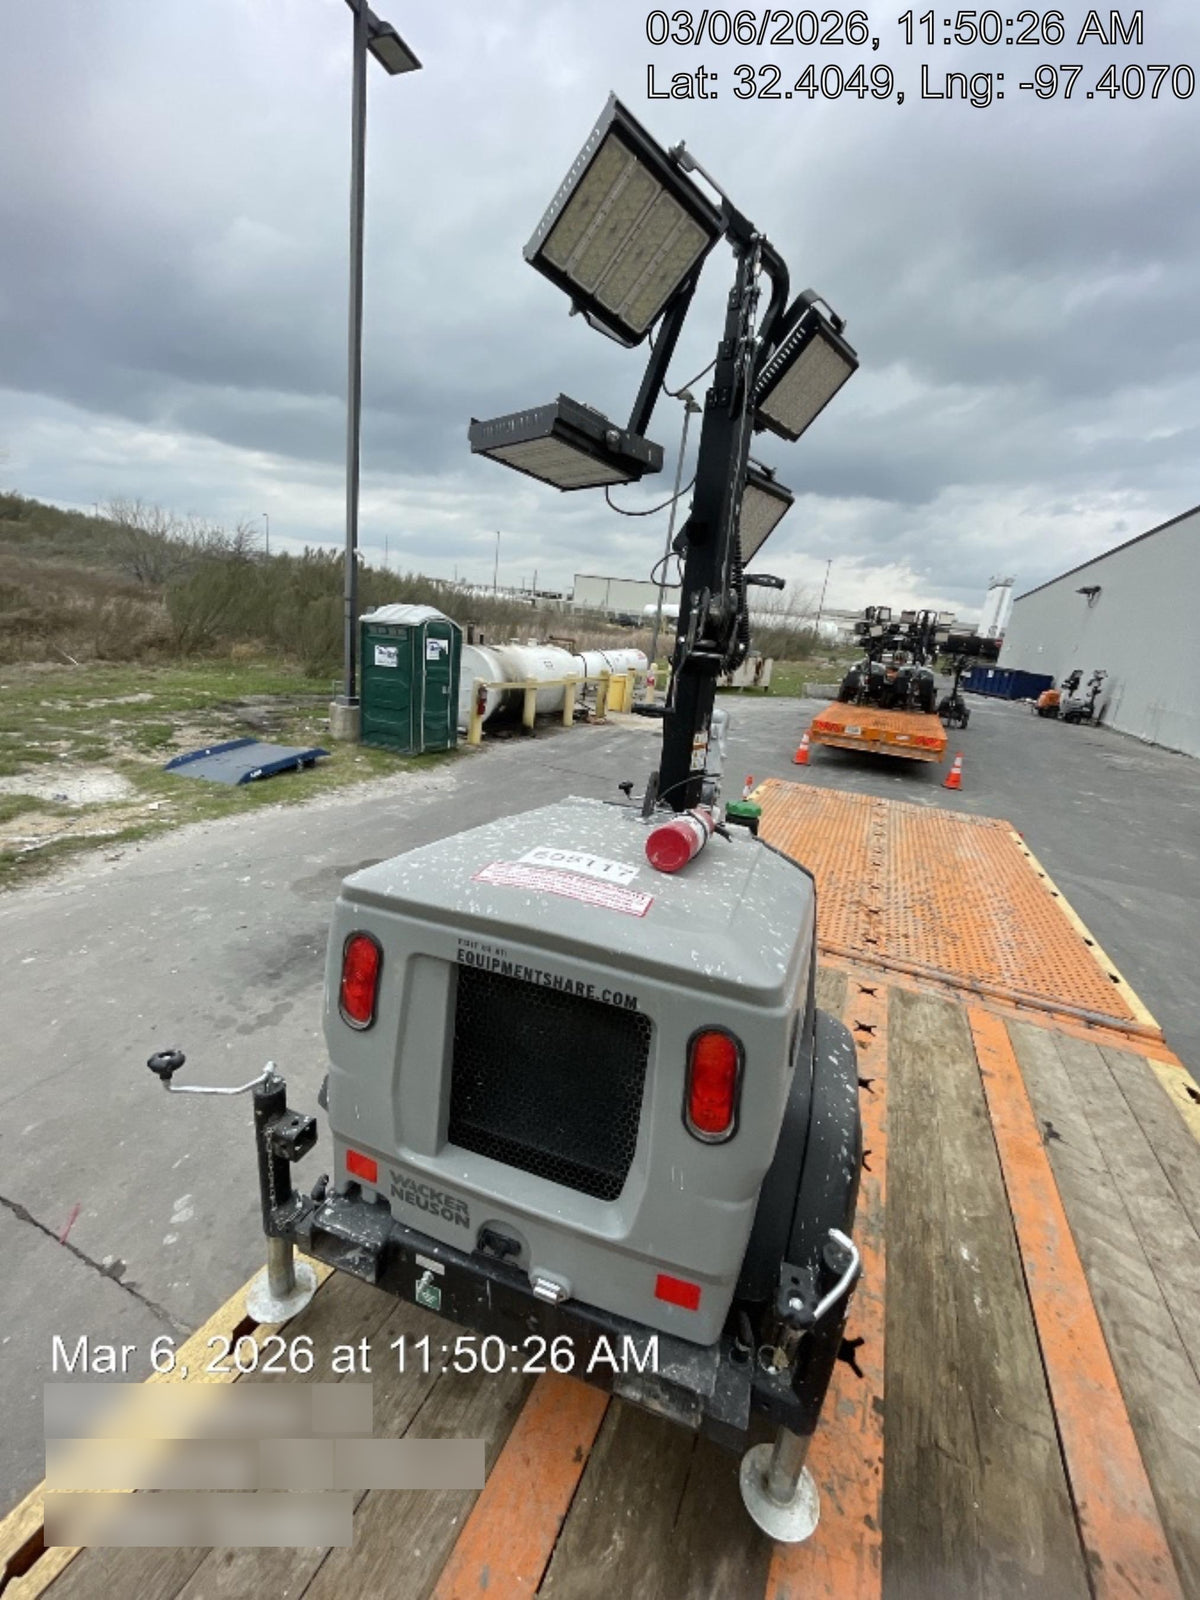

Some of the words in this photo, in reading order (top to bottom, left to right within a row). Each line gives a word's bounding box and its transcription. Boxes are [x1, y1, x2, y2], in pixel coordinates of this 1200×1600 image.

[456, 948, 638, 1011] EQUIPMENTSHARE.COM
[389, 1169, 469, 1217] WACKER
[390, 1183, 470, 1229] NEUSON
